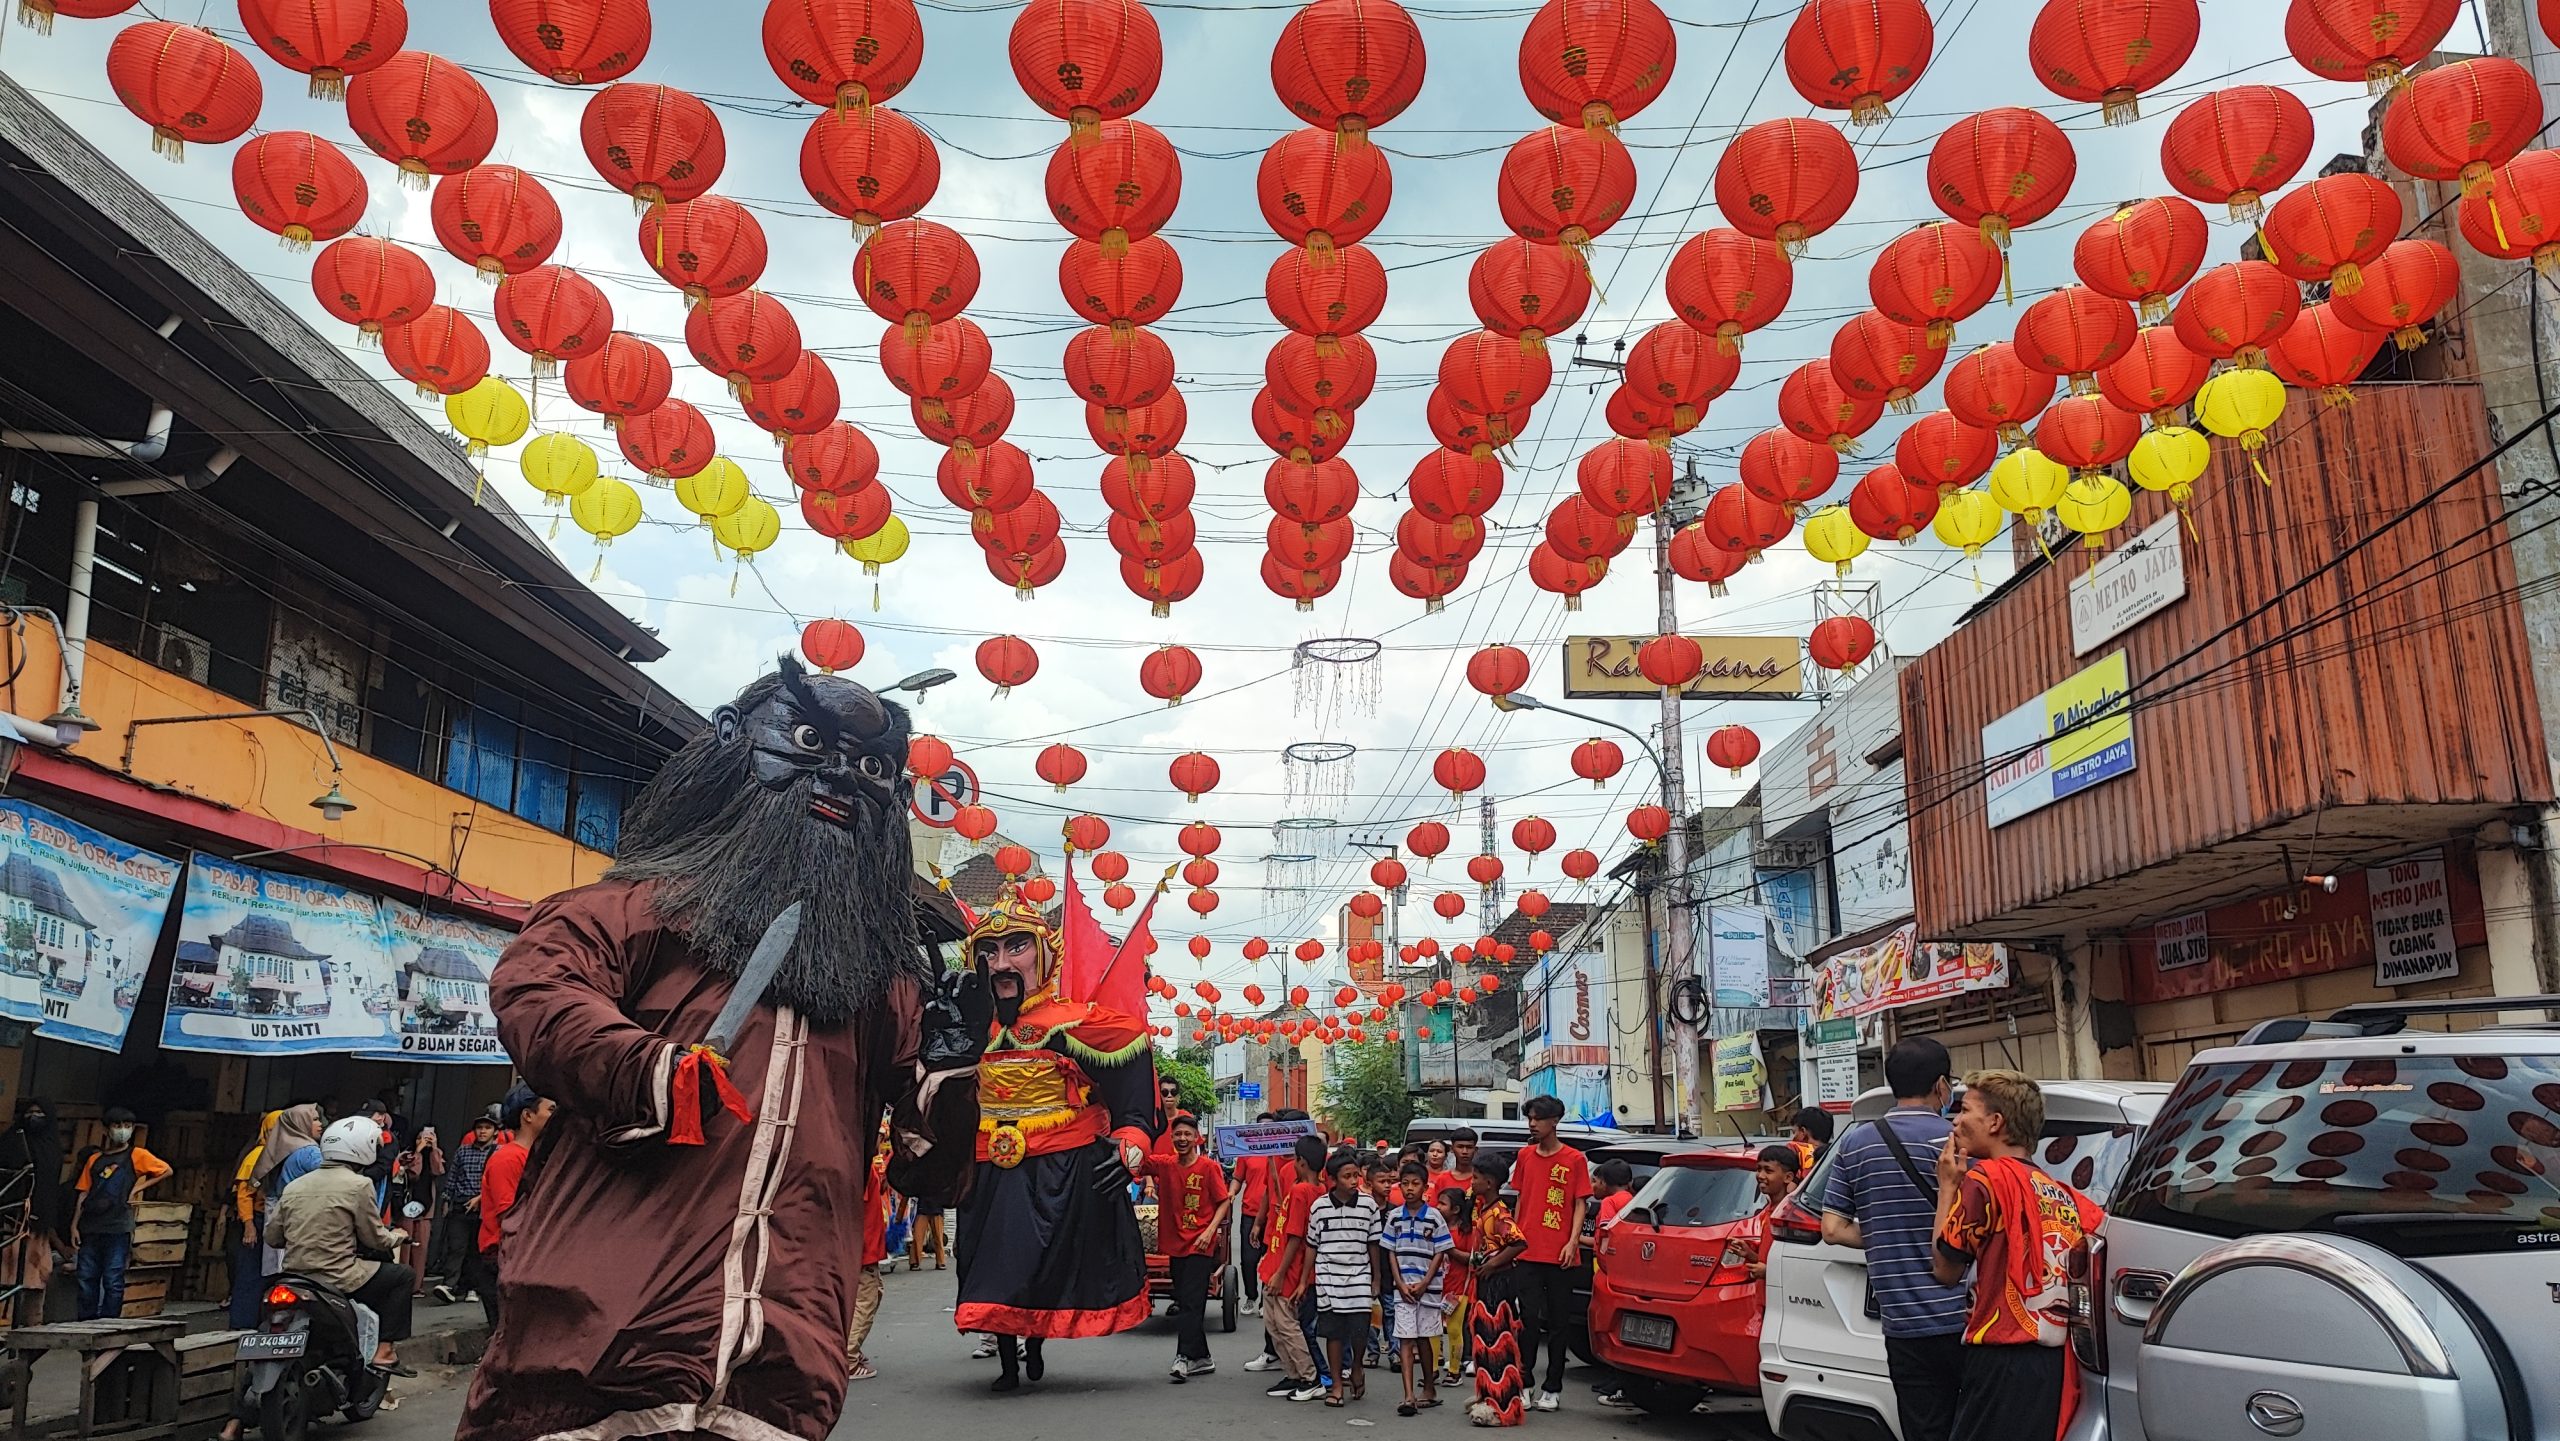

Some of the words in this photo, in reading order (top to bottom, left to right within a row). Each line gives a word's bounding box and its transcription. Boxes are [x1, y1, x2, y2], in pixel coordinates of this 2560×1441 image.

[2095, 569, 2136, 615] METRO
[2145, 545, 2178, 583] JAYA
[1587, 637, 1784, 690] Rayana
[2066, 687, 2121, 730] Miyako
[2057, 771, 2070, 781] Toko
[2070, 755, 2102, 779] METRO
[2103, 744, 2128, 764] JAYA
[28, 818, 79, 854] GEDE
[81, 840, 120, 872] ORA
[123, 859, 171, 888] SARE
[210, 867, 260, 896] PASAR
[305, 890, 340, 907] ORA
[2388, 861, 2420, 884] TOKO
[2372, 886, 2412, 911] METRO
[2414, 879, 2443, 906] JAYA
[2156, 921, 2183, 939] METRO
[2185, 915, 2205, 934] JAYA
[2376, 915, 2410, 937] TIDAK
[2412, 908, 2445, 931] BUKA
[2160, 942, 2185, 967] JUAL
[2187, 935, 2207, 960] STB
[2301, 914, 2370, 971] JAYA
[2389, 932, 2436, 957] CABANG
[2382, 951, 2452, 979] DIMANAPUN
[1569, 970, 1591, 1041] Cosmos
[251, 1023, 269, 1037] UD
[271, 1022, 321, 1037] TANTI
[417, 1036, 455, 1052] BUAH
[458, 1038, 497, 1053] SEGAR
[2517, 1232, 2560, 1244] astra
[1788, 1295, 1825, 1309] LIVINA
[242, 1337, 256, 1347] AD
